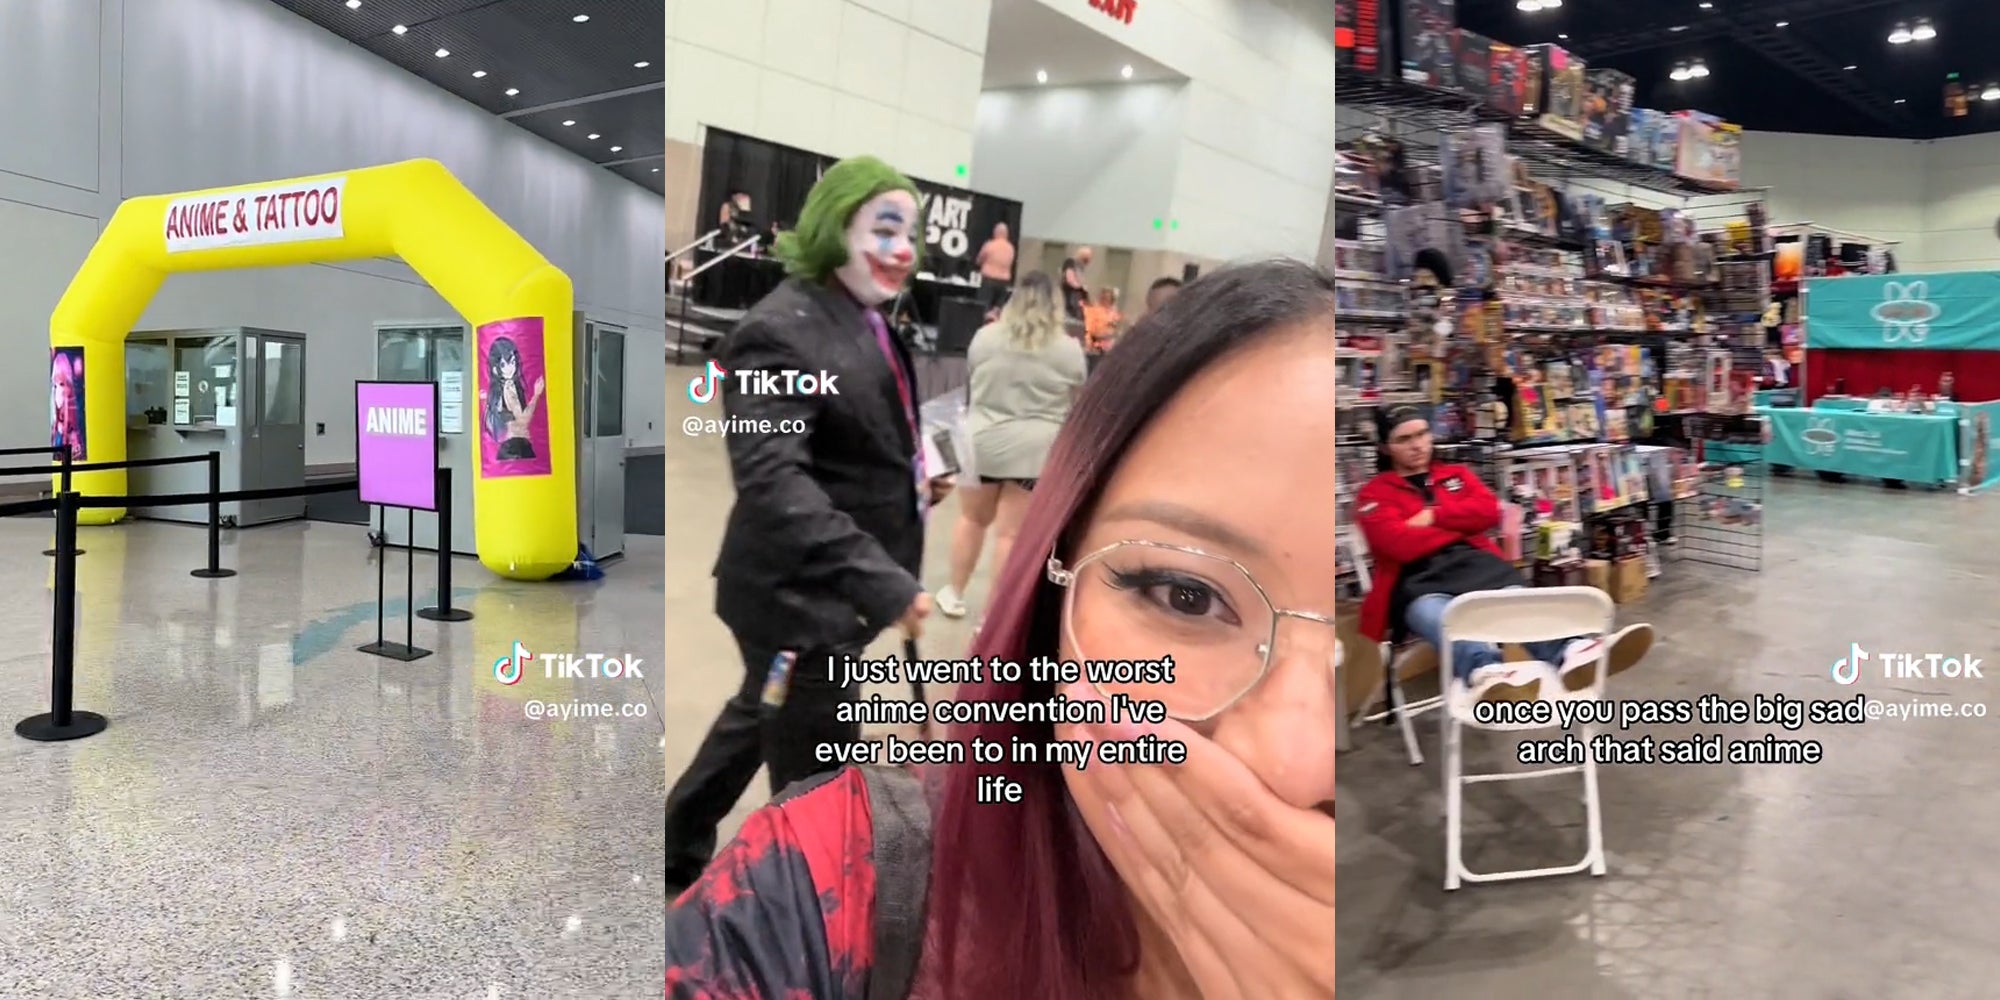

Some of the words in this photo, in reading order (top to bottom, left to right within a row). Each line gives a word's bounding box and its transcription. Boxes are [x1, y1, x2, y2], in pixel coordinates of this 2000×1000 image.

[166, 200, 229, 240] ANIME
[232, 198, 249, 233] &
[254, 186, 338, 231] TATTOO
[928, 194, 972, 230] ART
[366, 406, 427, 436] ANIME
